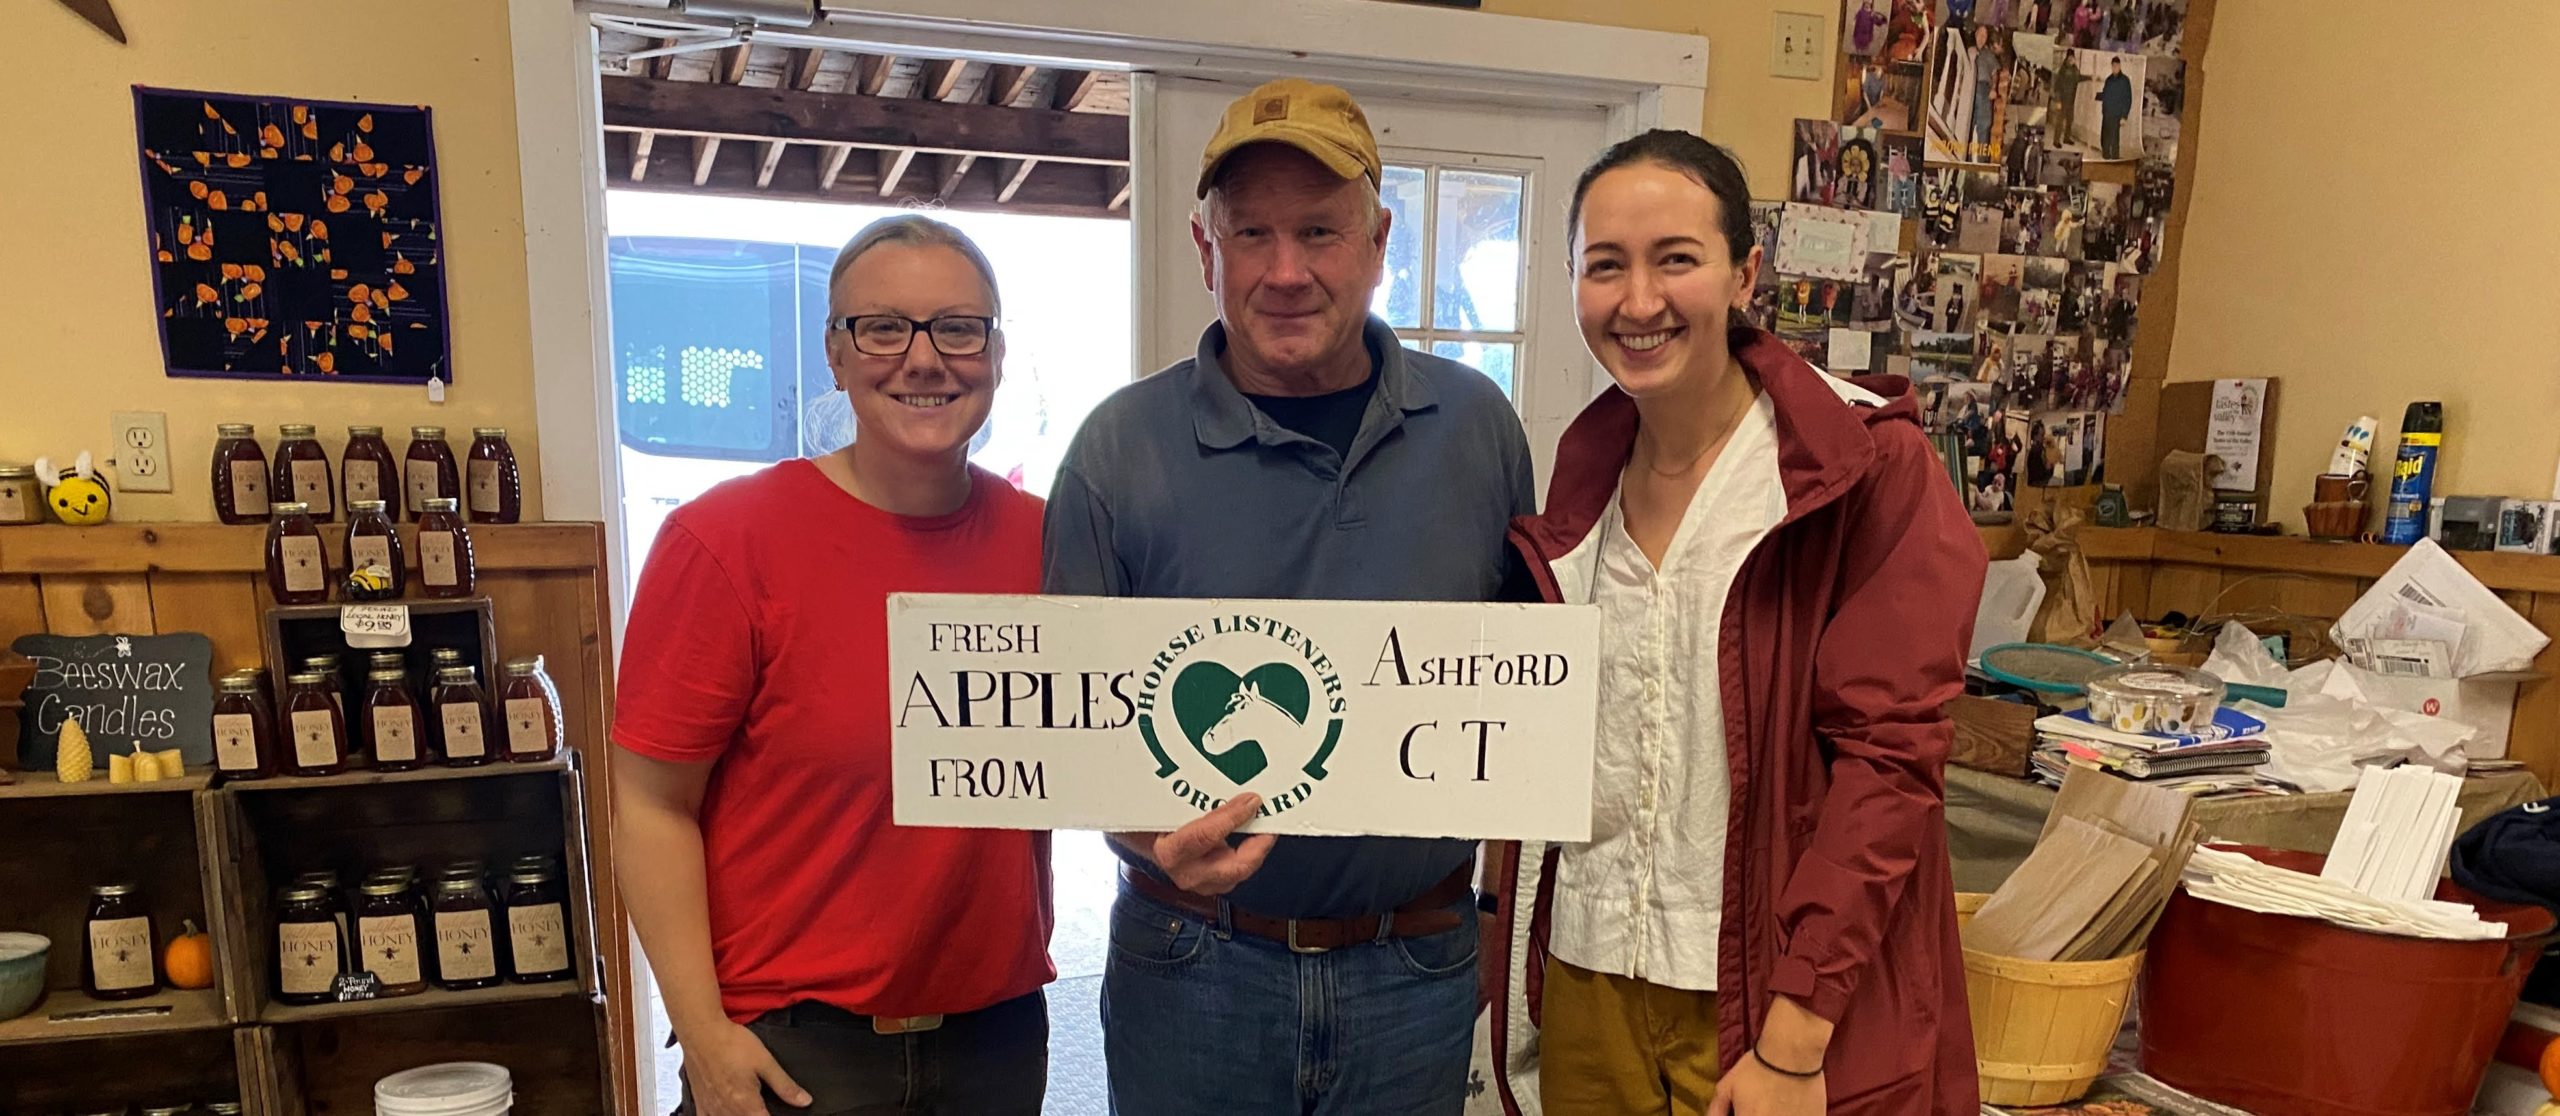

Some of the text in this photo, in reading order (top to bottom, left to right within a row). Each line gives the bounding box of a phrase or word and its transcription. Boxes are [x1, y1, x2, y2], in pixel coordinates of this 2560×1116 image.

[929, 623, 1041, 653] FRESH
[1137, 615, 1347, 713] HORSE LISTENERS
[27, 656, 186, 690] Beeswax
[896, 669, 1136, 730] APPLES
[39, 694, 175, 739] Candles
[445, 716, 479, 726] HONEY
[509, 710, 541, 721] HONEY
[295, 723, 330, 734] HONEY
[377, 719, 410, 728] HONEY
[217, 727, 250, 737] HONEY
[929, 758, 1048, 800] FROM
[512, 920, 560, 934] HONEY
[93, 933, 147, 949] HONEY
[363, 932, 413, 946] HONEY
[438, 928, 488, 941] HONEY
[282, 939, 335, 952] HONEY
